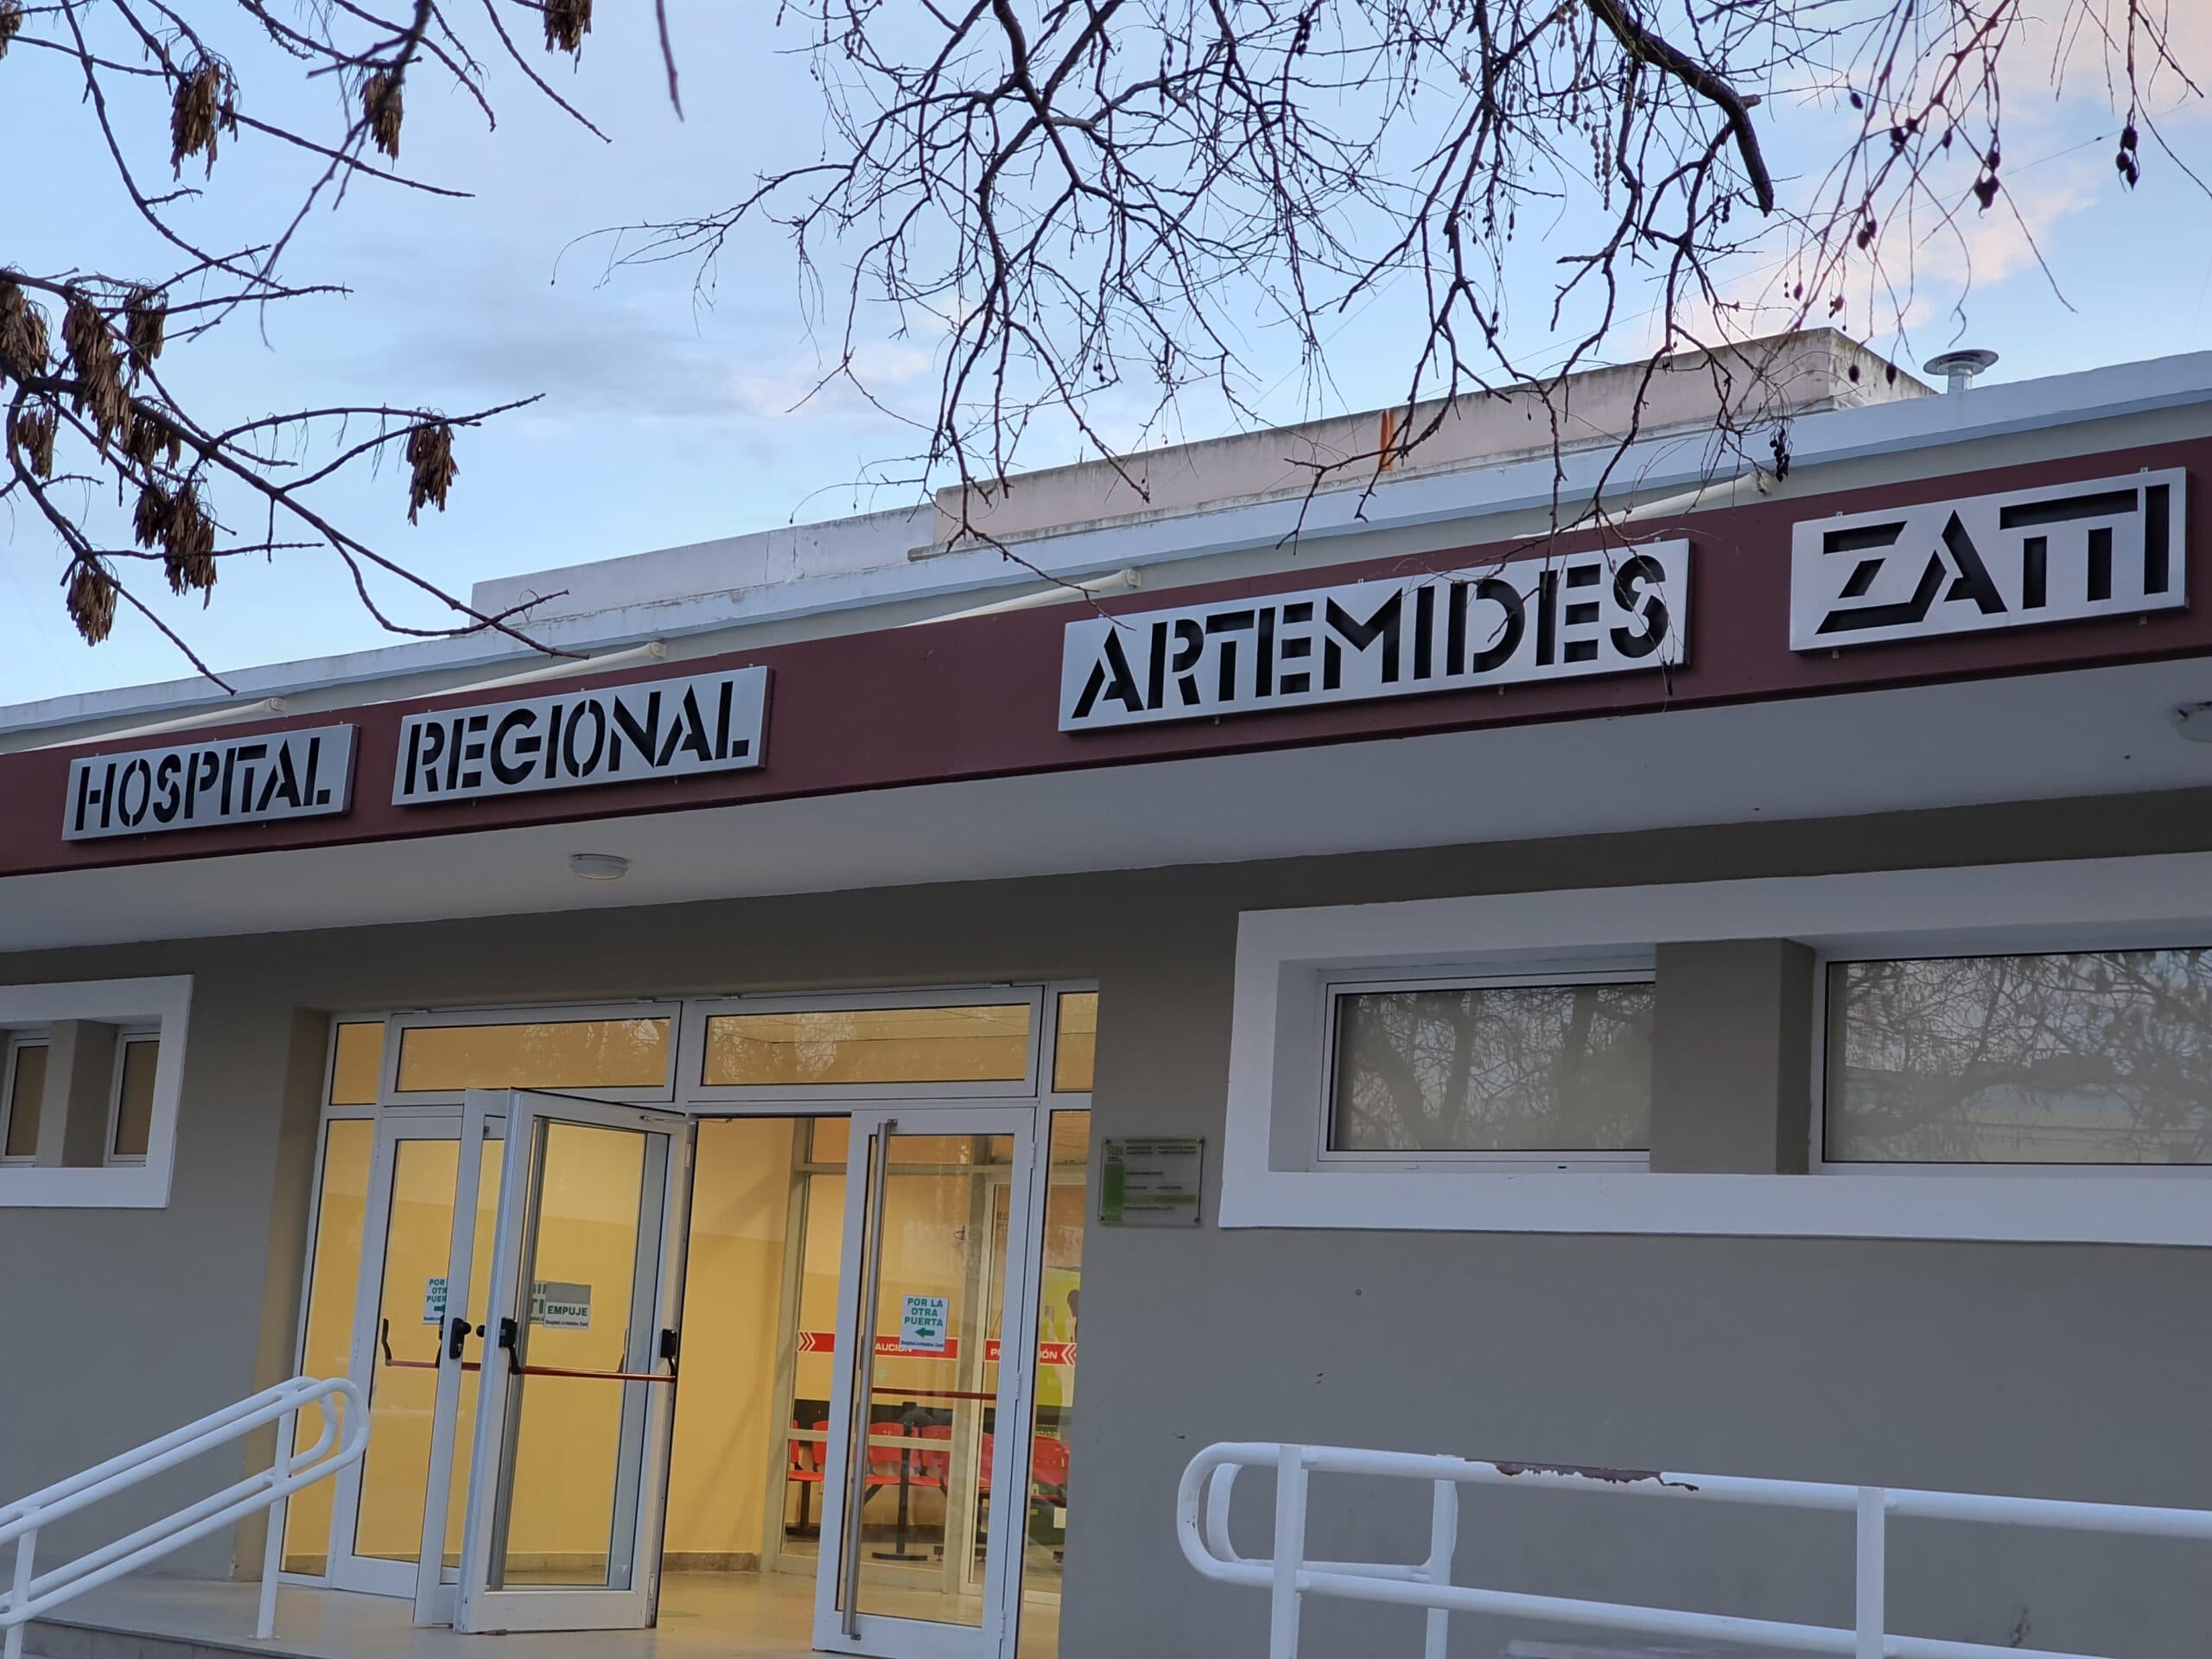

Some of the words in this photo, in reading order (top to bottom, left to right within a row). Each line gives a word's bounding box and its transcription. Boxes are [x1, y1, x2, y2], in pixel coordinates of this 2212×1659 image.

[74, 736, 332, 831] HOSPITAL
[403, 680, 750, 795] REGIONAL
[1071, 554, 1668, 719] ARTEMIDES
[1814, 483, 2171, 634] ZATTI
[907, 1298, 927, 1306] POR
[547, 1306, 588, 1316] EMPUJE
[911, 1307, 938, 1317] OTRA
[904, 1316, 944, 1326] PUERTA
